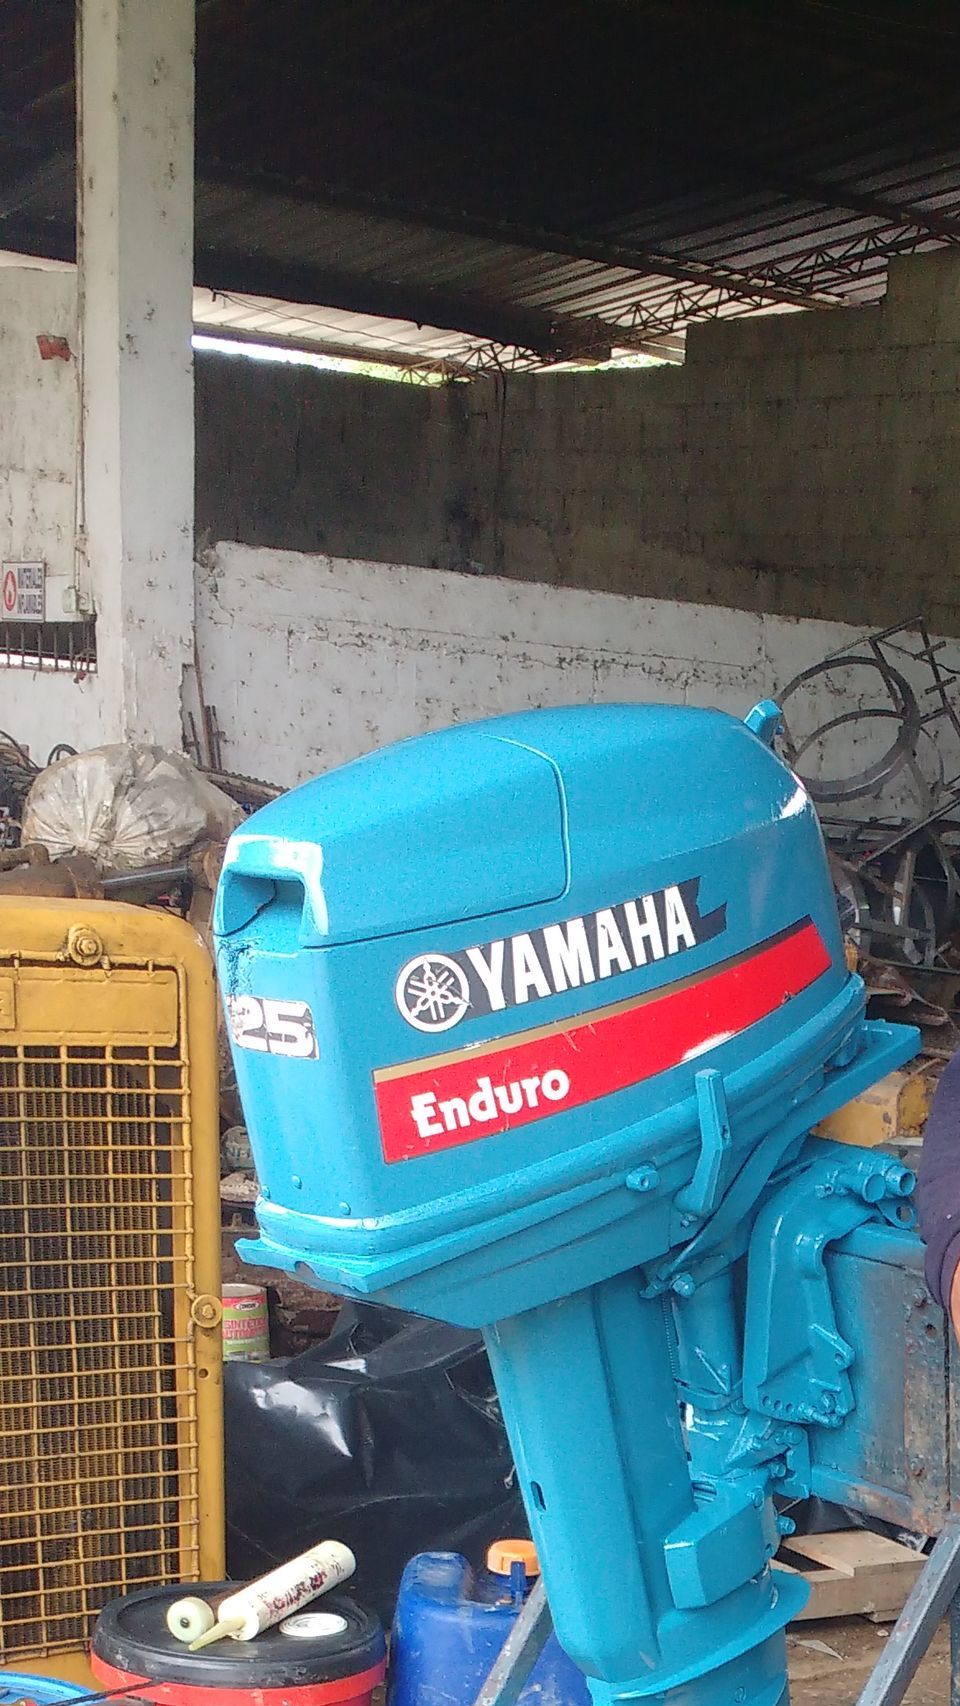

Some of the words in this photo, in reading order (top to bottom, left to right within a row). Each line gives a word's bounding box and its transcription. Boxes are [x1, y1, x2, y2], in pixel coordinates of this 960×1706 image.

[466, 886, 696, 1011] YAMAHA
[227, 995, 315, 1058] 25
[410, 1068, 570, 1138] Enduro
